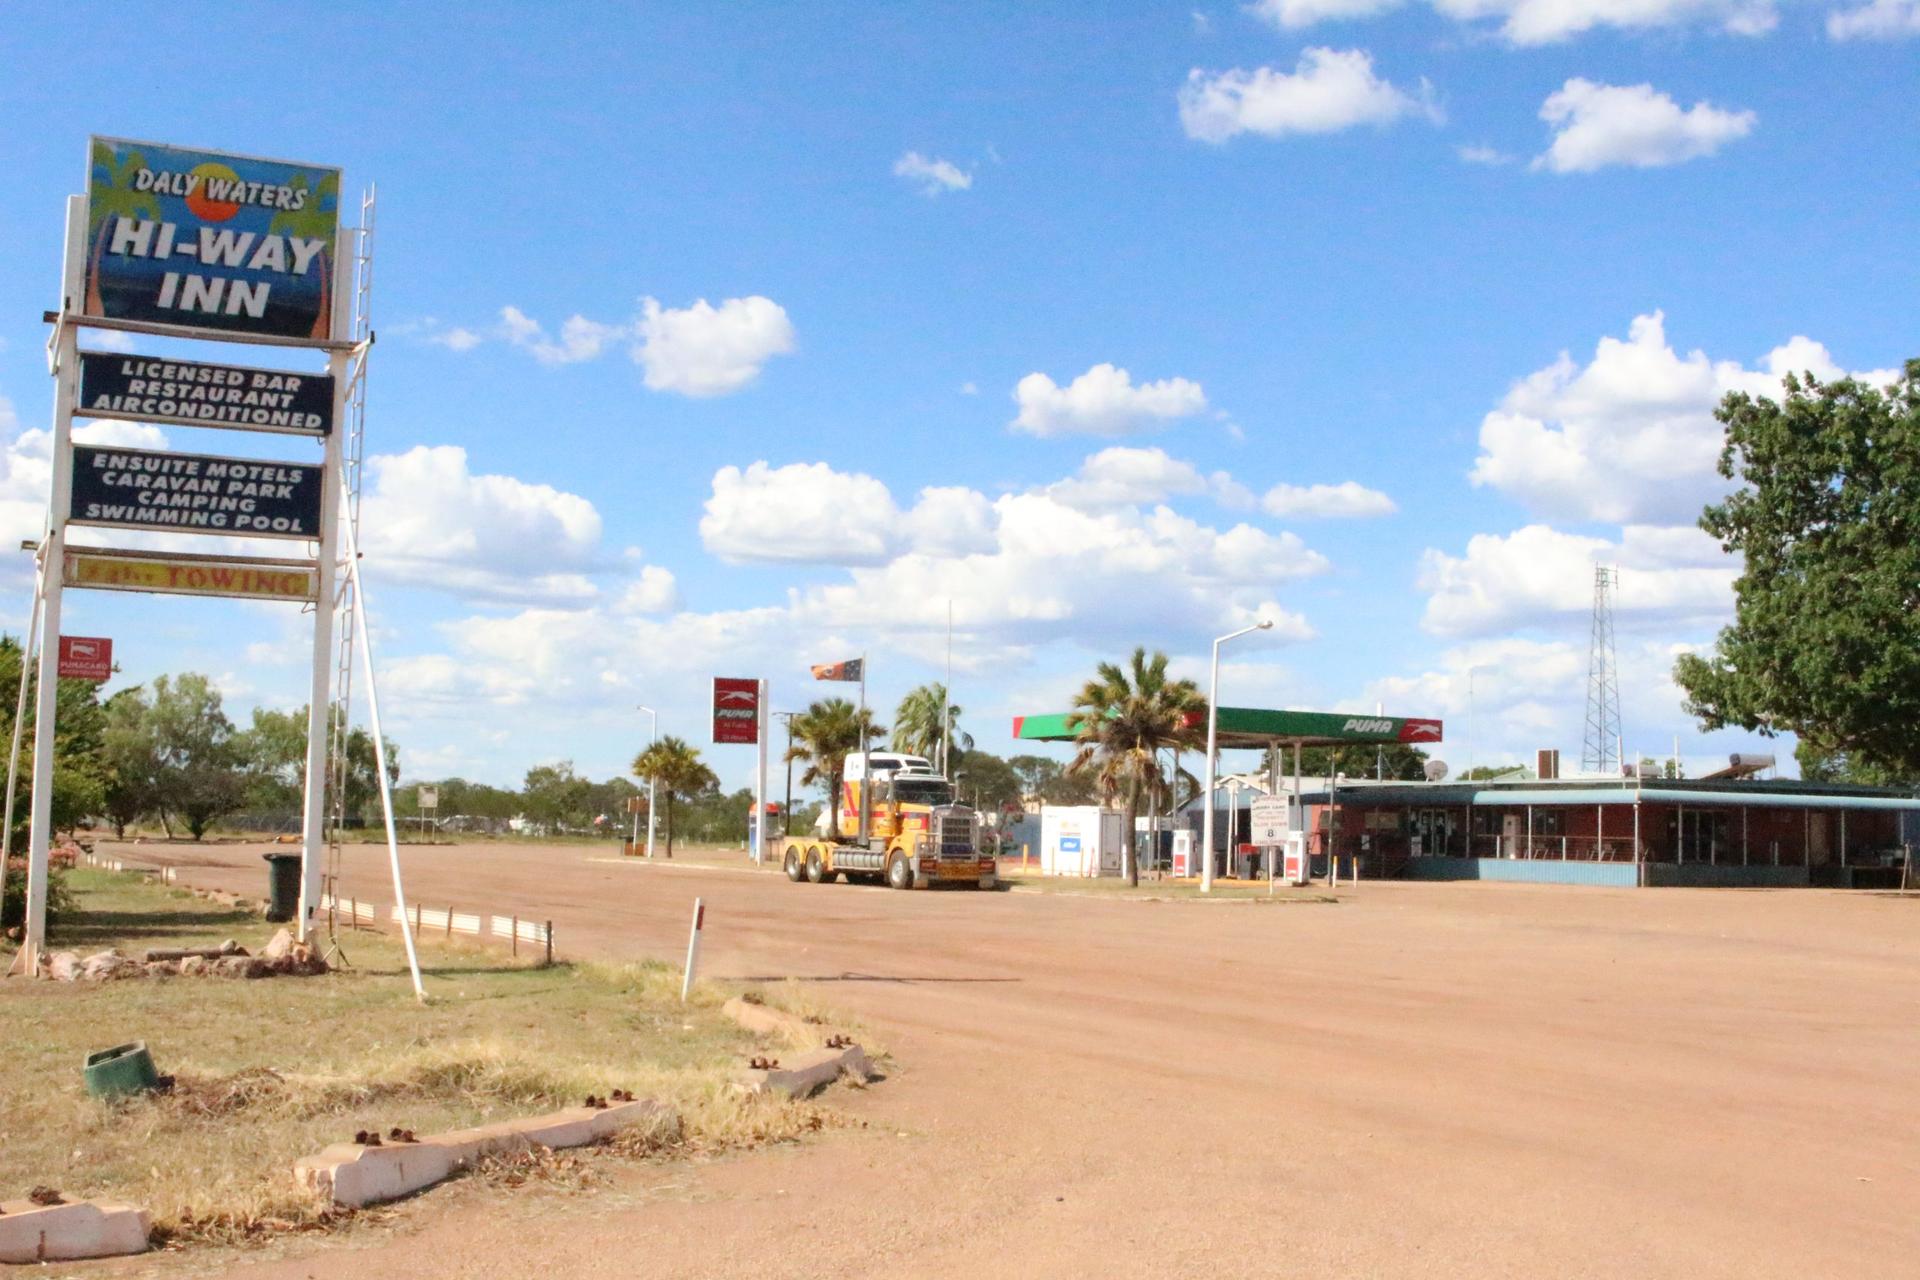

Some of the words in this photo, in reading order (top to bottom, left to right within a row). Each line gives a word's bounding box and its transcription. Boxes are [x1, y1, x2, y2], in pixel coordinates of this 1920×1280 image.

[135, 167, 200, 196] DALY
[207, 177, 308, 211] WATERS
[109, 216, 327, 275] HI-WAY
[156, 272, 271, 318] INN
[121, 360, 245, 386] LICENSED
[251, 375, 302, 393] BAR
[128, 379, 295, 409] RESTAURANT
[93, 394, 323, 429] AIRCONDITIONED
[92, 453, 200, 477] ENSUITE
[205, 462, 304, 484] MOTELS
[101, 471, 221, 495] CARAVAN
[227, 481, 295, 500] PARK
[137, 490, 257, 513] CAMPING
[85, 503, 228, 528] SWIMMING
[234, 515, 304, 533] POOL
[166, 565, 306, 596] TOWING
[718, 709, 754, 719] PUMA
[1343, 719, 1393, 733] PUMA
